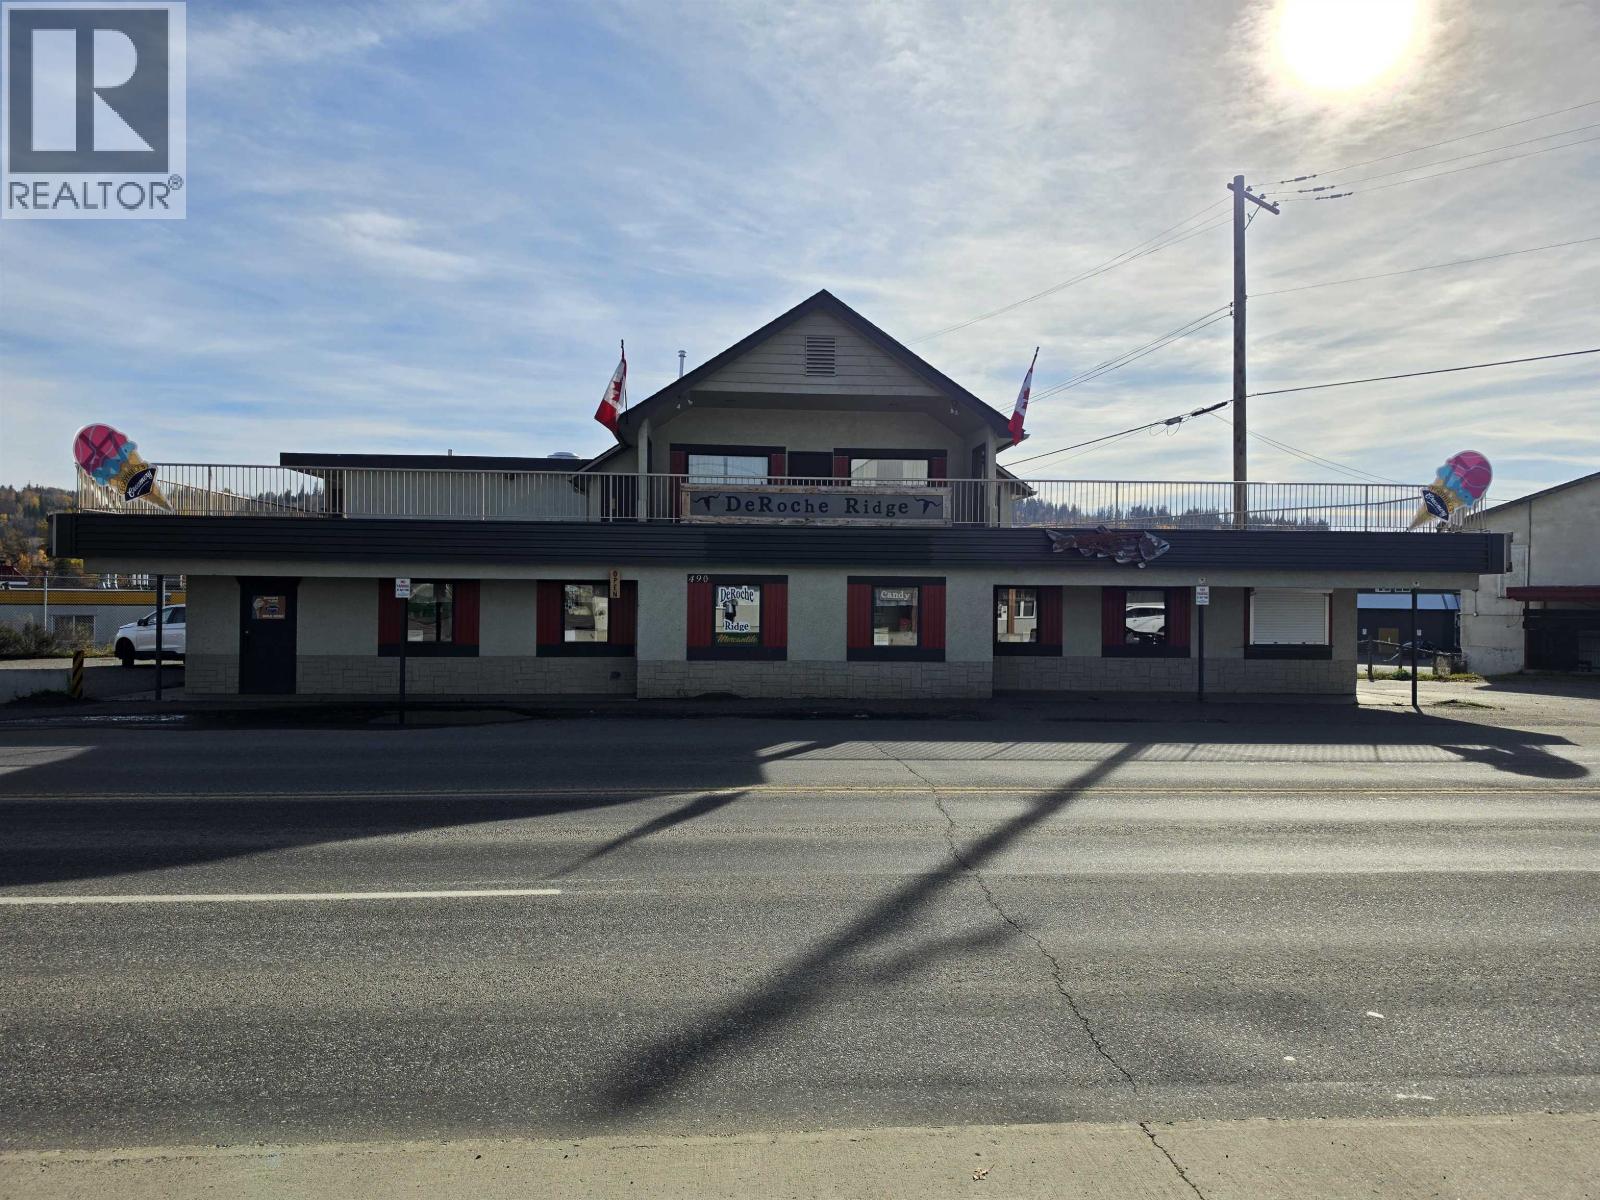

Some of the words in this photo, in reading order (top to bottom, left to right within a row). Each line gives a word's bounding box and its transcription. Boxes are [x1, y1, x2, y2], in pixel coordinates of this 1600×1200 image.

[725, 495, 829, 514] DeRoche
[845, 497, 909, 517] Ridge
[688, 575, 709, 583] 490
[720, 586, 754, 602] DeRoche
[880, 590, 911, 601] Candy
[724, 620, 750, 632] Ridge
